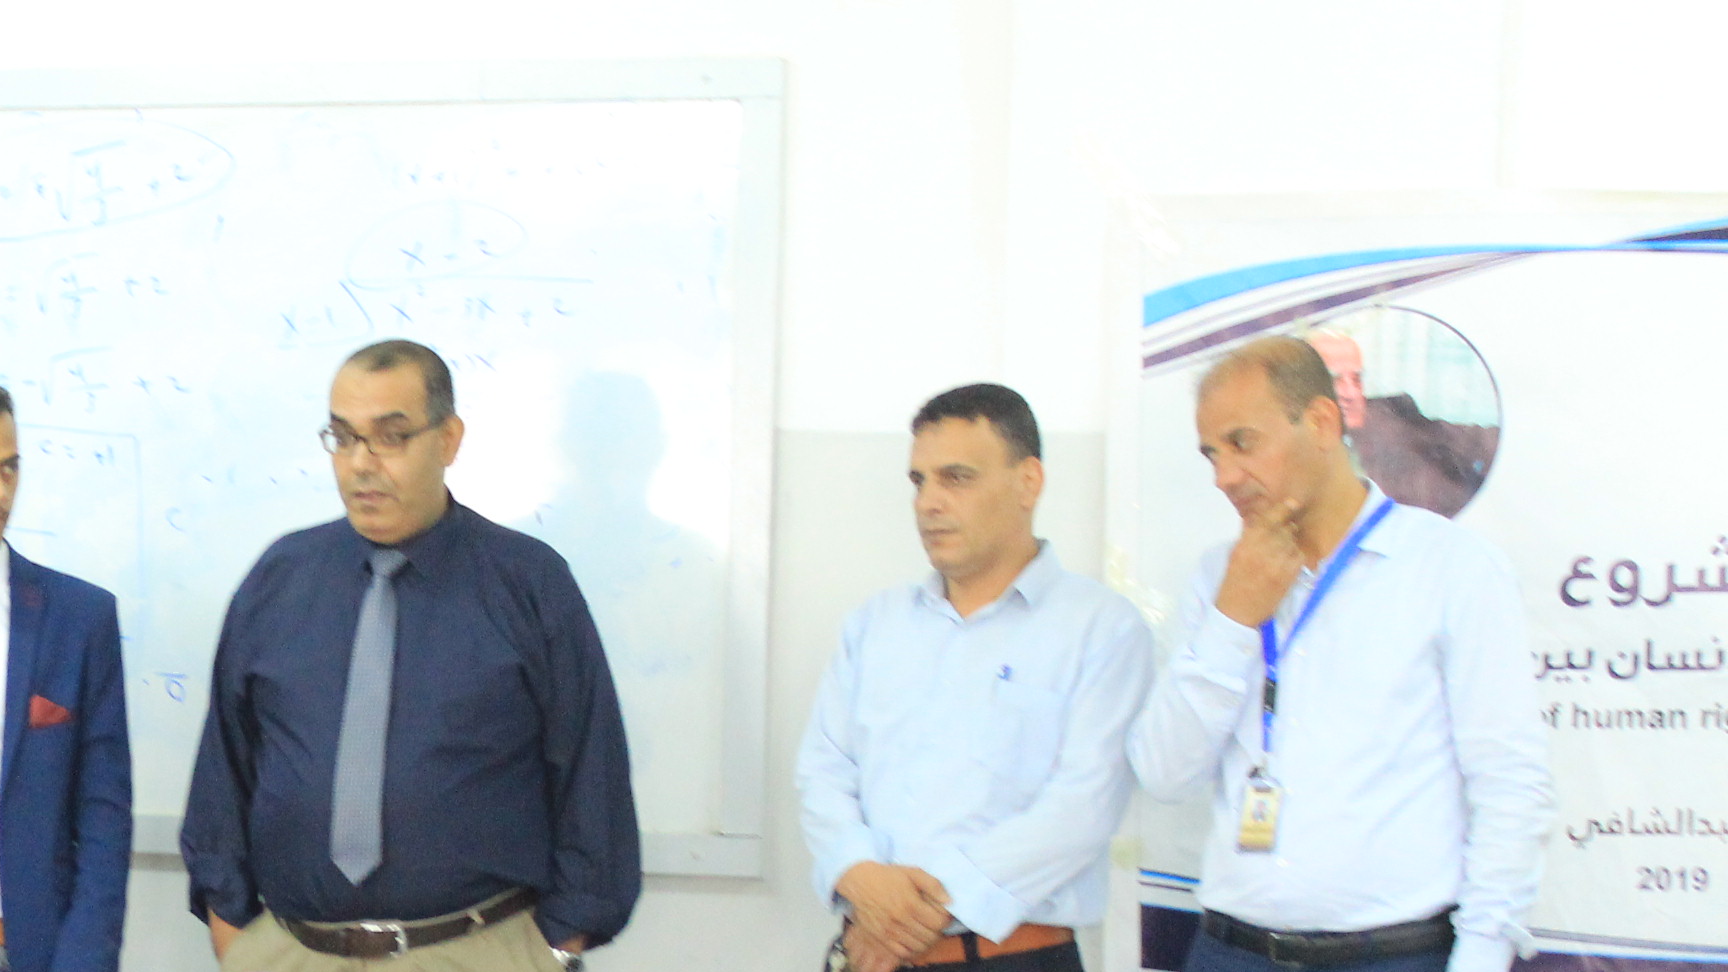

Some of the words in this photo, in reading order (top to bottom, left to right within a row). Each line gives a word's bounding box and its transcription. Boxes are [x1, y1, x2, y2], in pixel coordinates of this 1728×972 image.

[1571, 702, 1688, 731] human
[1700, 702, 1728, 734] ri
[1635, 864, 1712, 894] 2019
